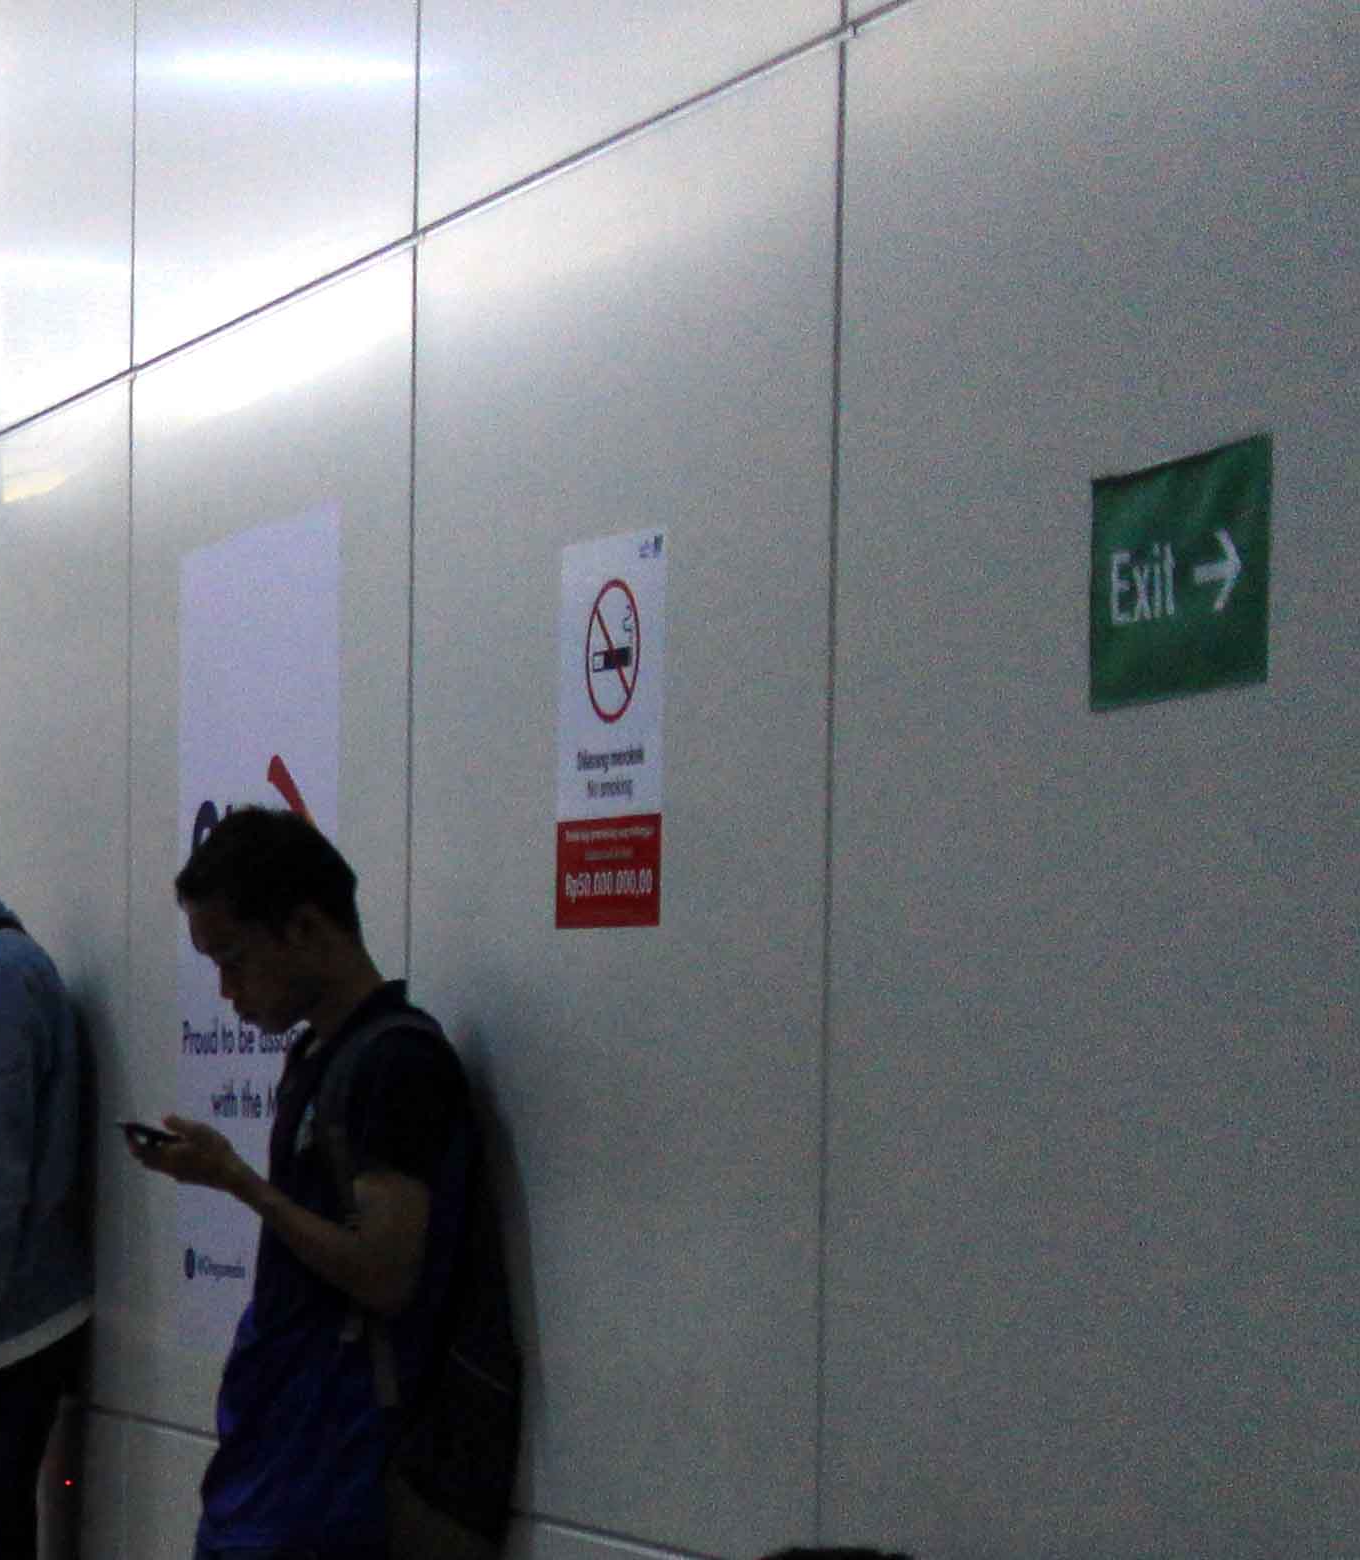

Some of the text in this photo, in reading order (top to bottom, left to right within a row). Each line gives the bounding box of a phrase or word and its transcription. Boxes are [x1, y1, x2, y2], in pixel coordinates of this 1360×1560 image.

[1111, 543, 1176, 625] Exit
[182, 1018, 219, 1054] Proud
[221, 1024, 234, 1053] to
[238, 1021, 257, 1053] be
[210, 1081, 238, 1118] with
[241, 1080, 262, 1118] the
